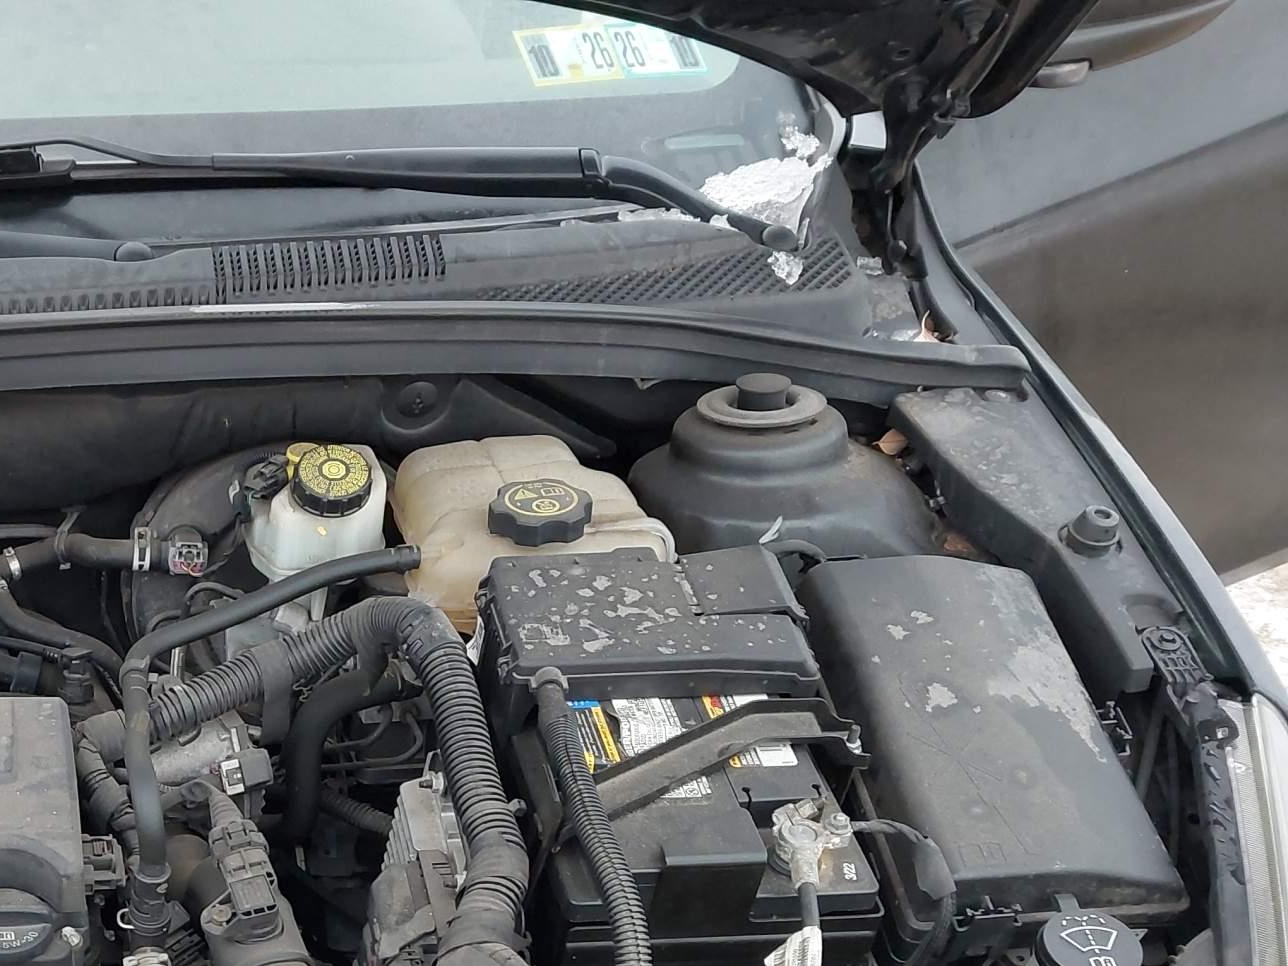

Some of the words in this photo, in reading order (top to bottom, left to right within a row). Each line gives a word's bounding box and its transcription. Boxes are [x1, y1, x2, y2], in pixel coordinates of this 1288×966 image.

[581, 31, 615, 69] 26
[613, 30, 646, 68] 26
[842, 862, 858, 882] 3/22
[1, 931, 39, 949] 5W-30
